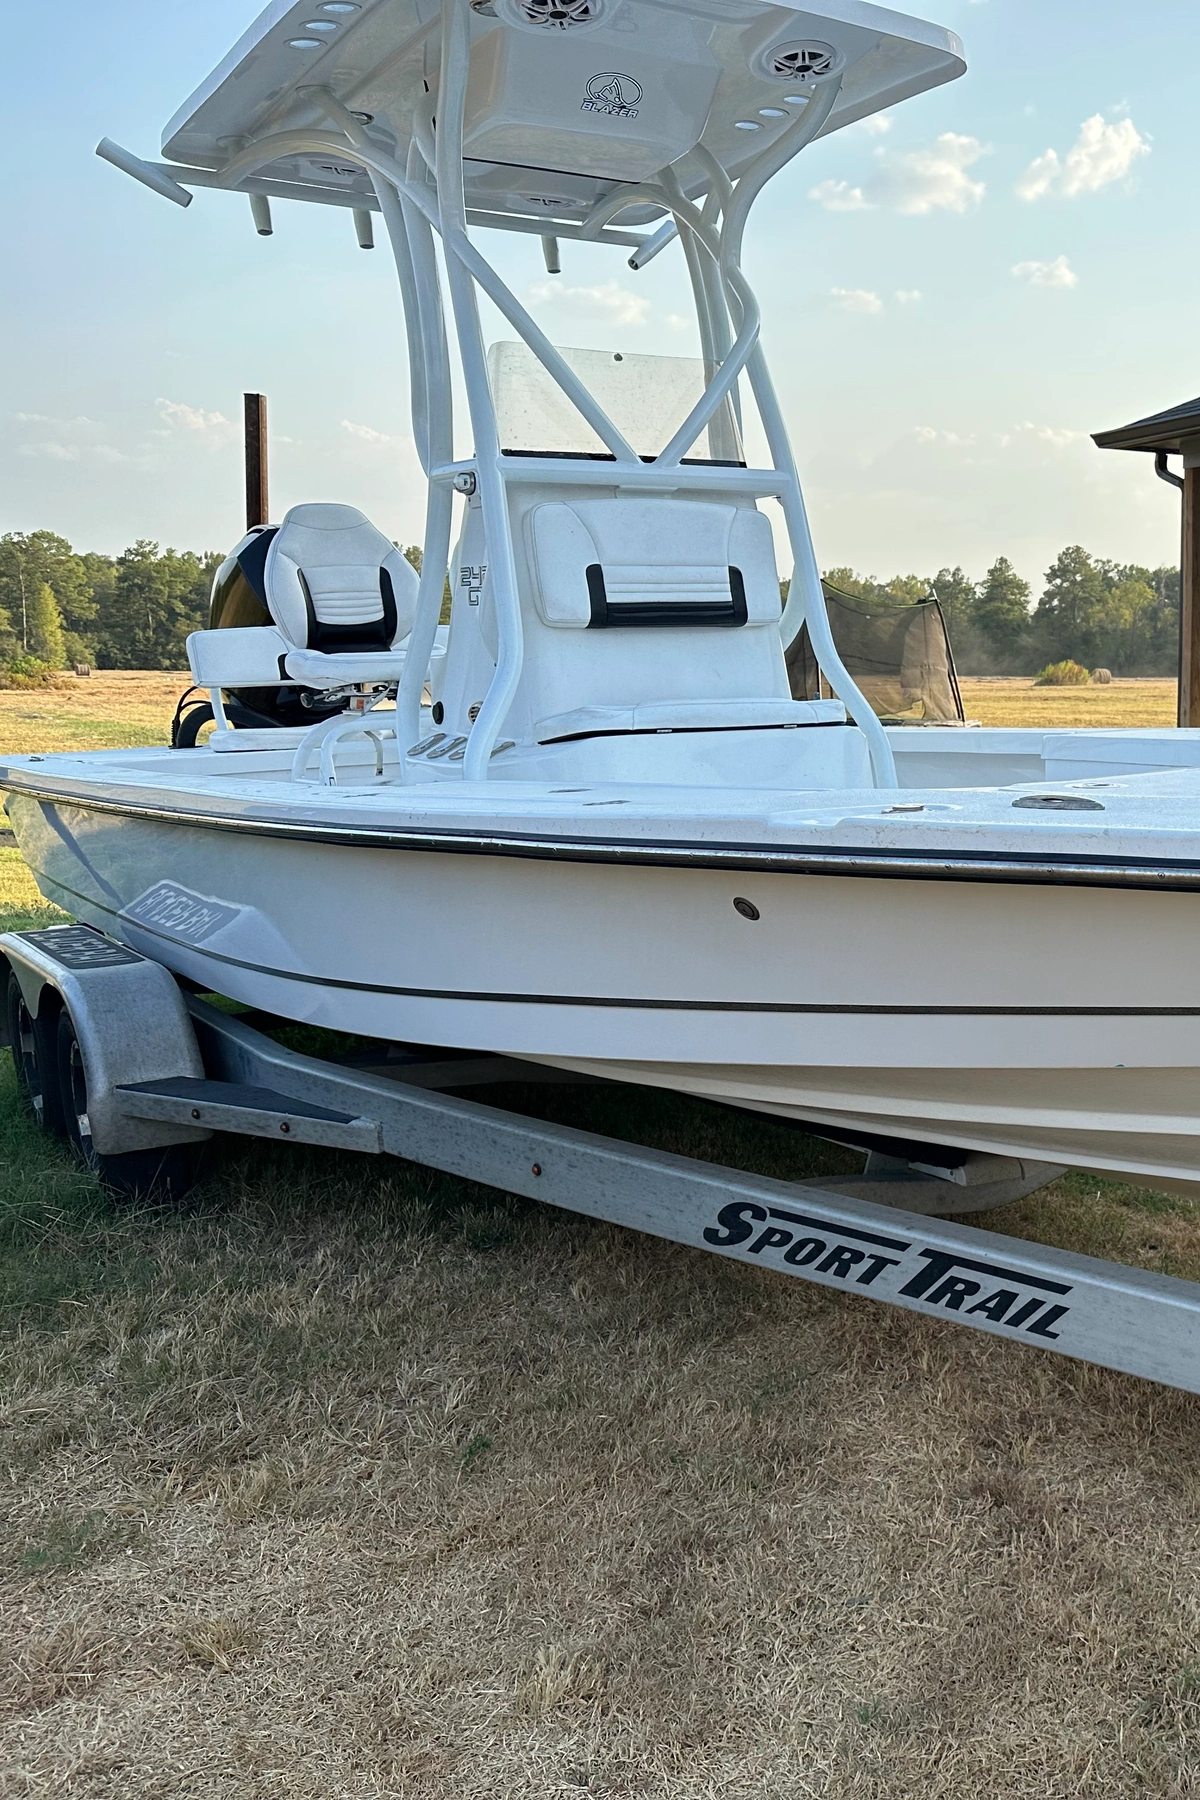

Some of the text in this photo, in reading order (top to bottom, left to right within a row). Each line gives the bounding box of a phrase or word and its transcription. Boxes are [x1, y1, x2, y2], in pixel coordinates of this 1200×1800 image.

[580, 100, 639, 118] BLAZER
[703, 1201, 1074, 1340] SPORT TRAIL
